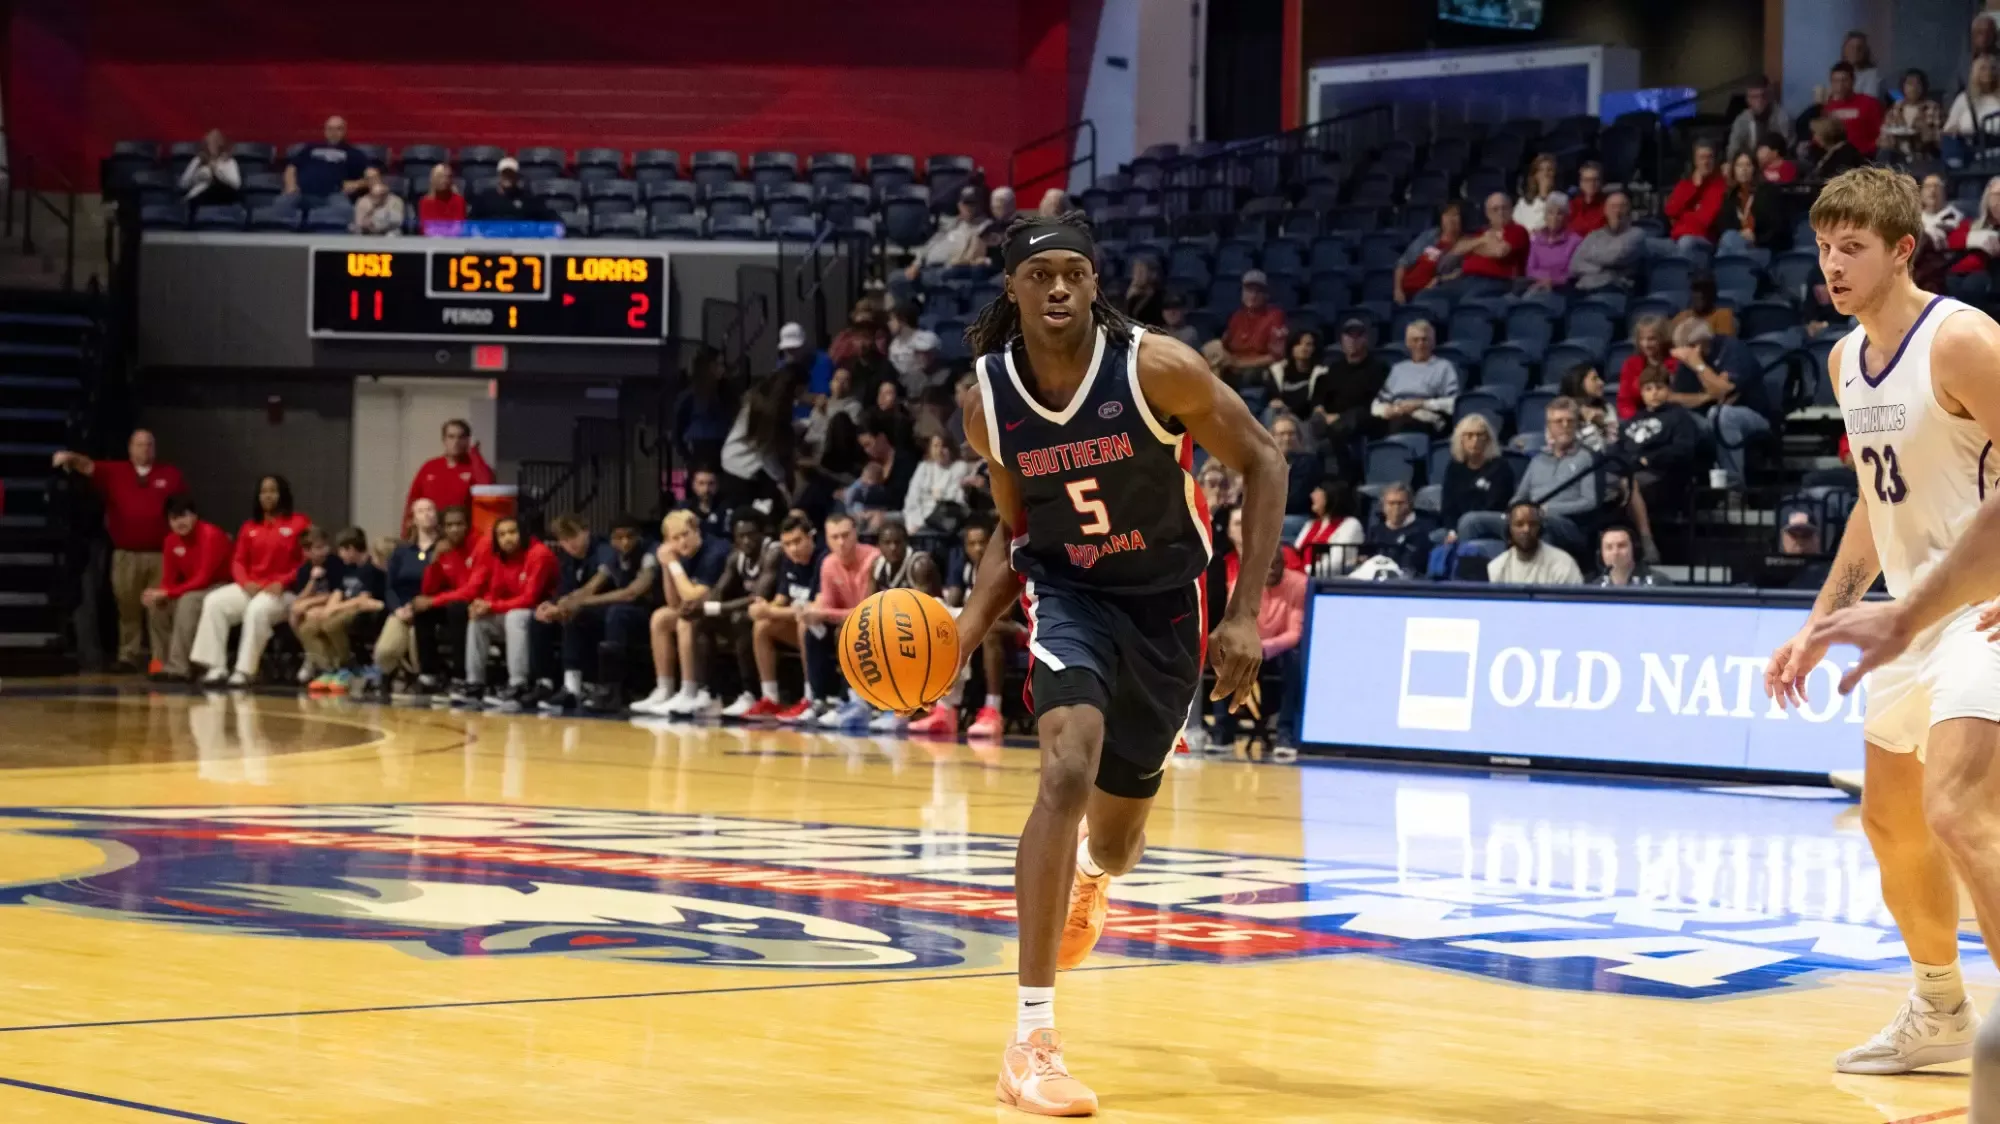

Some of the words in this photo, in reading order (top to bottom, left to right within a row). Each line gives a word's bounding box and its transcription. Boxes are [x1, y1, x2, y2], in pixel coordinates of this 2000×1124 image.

[347, 253, 393, 278] USI
[449, 255, 541, 292] 15:27
[566, 257, 648, 282] LORAS
[350, 290, 383, 321] 11
[508, 305, 518, 329] 1
[627, 293, 650, 329] 2
[1848, 403, 1907, 435] DUHAWKS
[1017, 432, 1134, 477] SOUTHERN
[1861, 444, 1909, 504] 23
[1064, 477, 1112, 536] 5
[1064, 529, 1147, 569] INDIANA
[853, 604, 883, 687] Wilson
[895, 612, 917, 659] EVO
[1489, 646, 1622, 711] OLD
